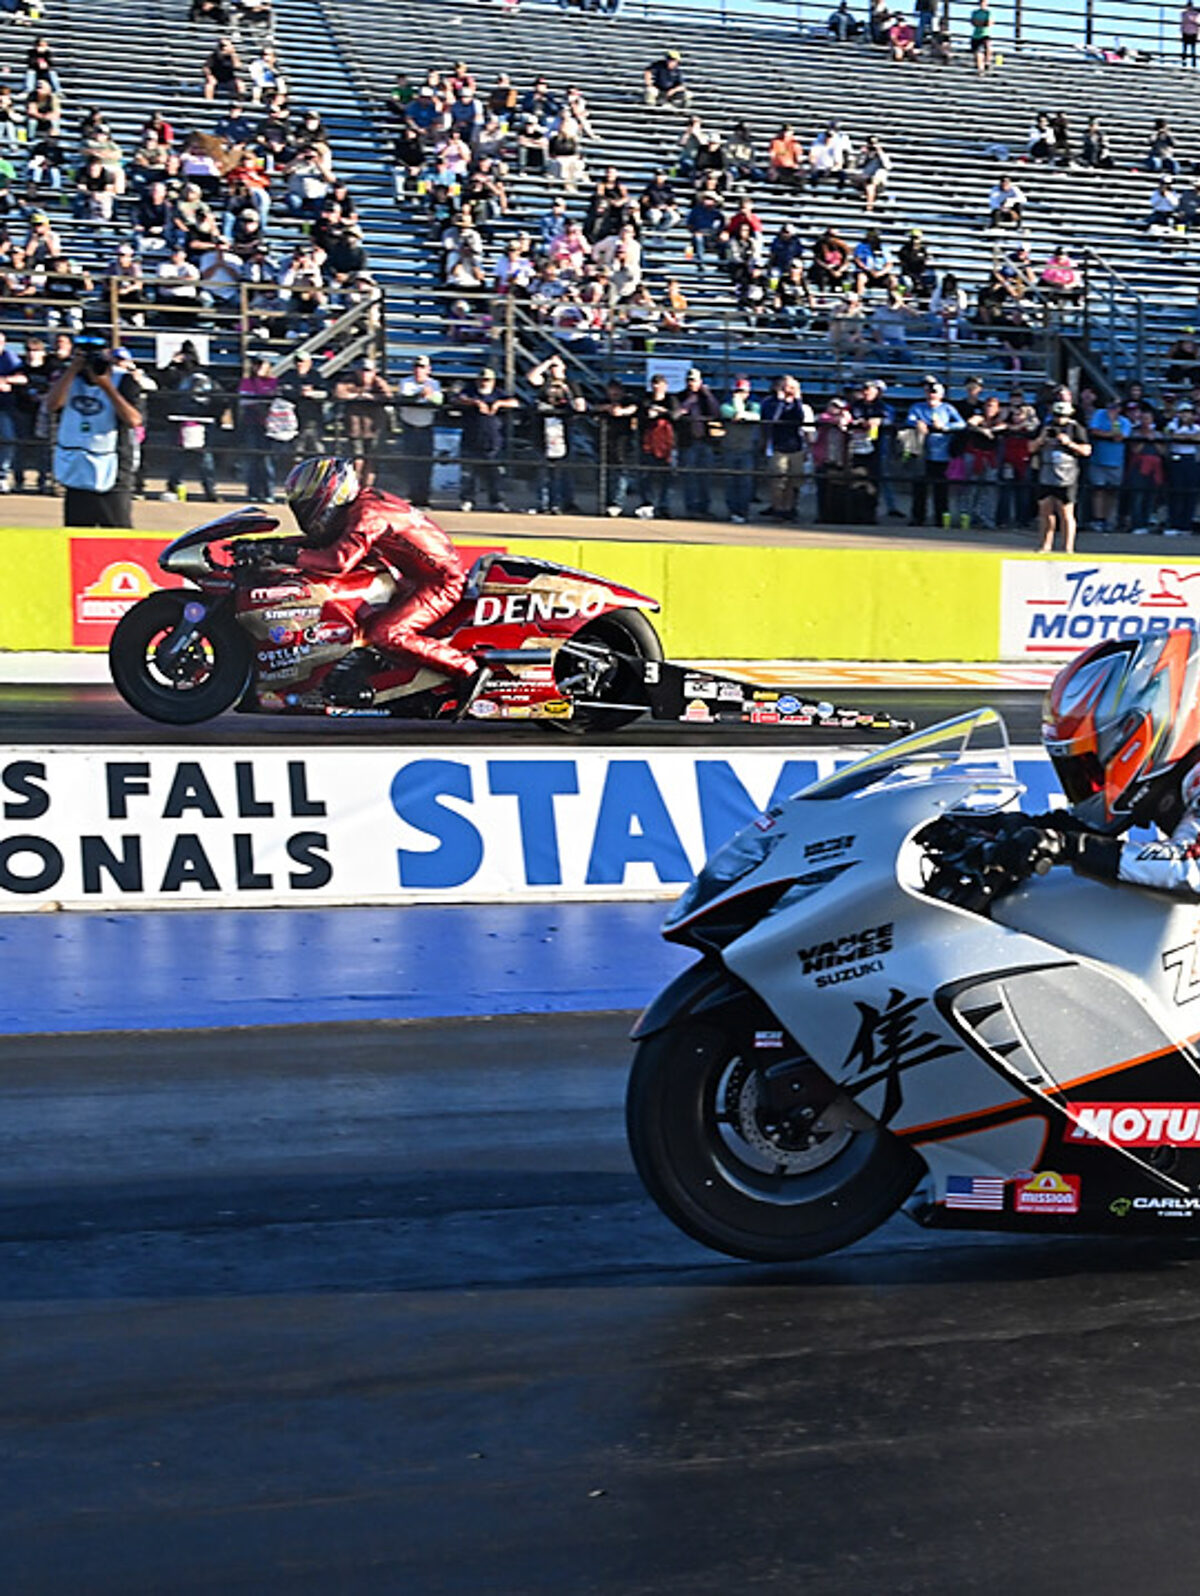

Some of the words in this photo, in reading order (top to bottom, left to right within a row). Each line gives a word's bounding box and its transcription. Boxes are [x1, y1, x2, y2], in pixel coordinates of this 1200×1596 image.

[474, 590, 606, 626] DENSO
[1066, 568, 1144, 612] Texas
[644, 661, 660, 684] 3
[106, 761, 327, 818] FALL
[798, 922, 894, 962] VANCE
[802, 938, 893, 975] HINES
[814, 960, 885, 988] SUZUKI
